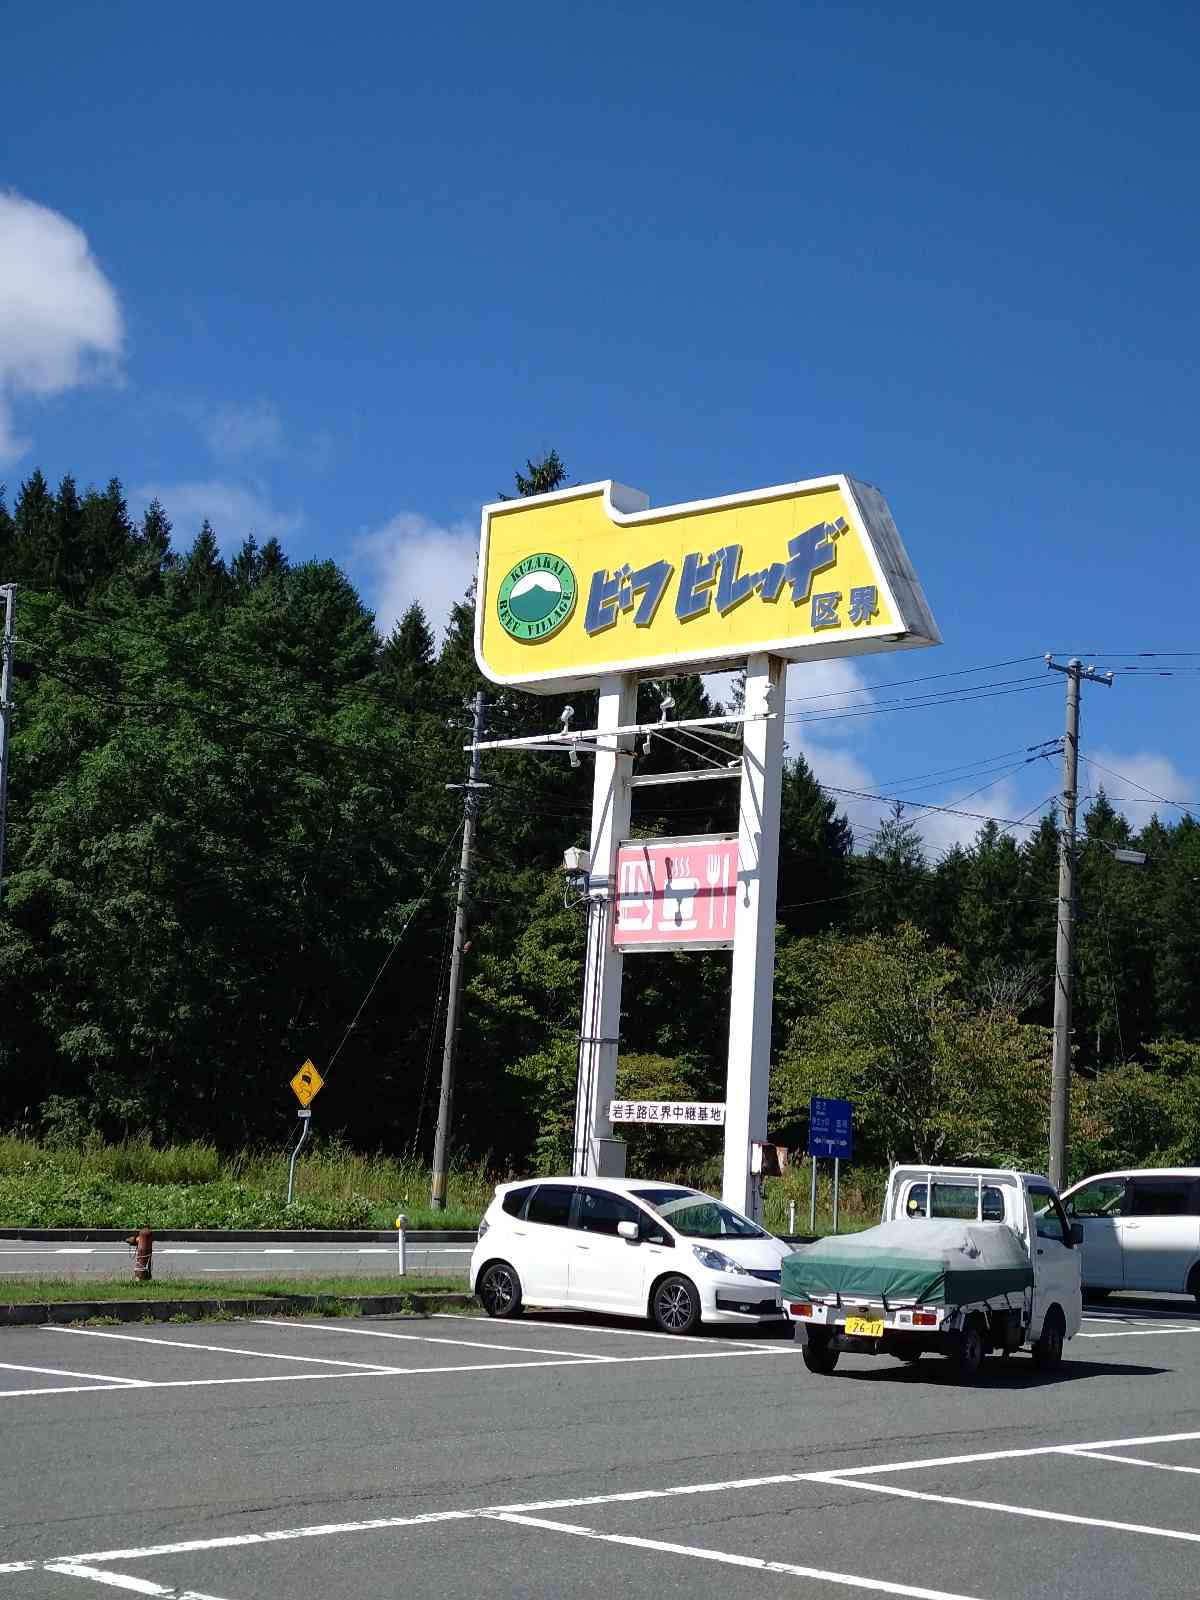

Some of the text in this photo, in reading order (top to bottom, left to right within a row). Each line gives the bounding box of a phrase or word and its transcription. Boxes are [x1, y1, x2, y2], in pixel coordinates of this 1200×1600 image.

[500, 600, 520, 632] BEEF
[810, 586, 878, 631] 区界
[612, 1104, 721, 1121] 岩手路区界中継基地
